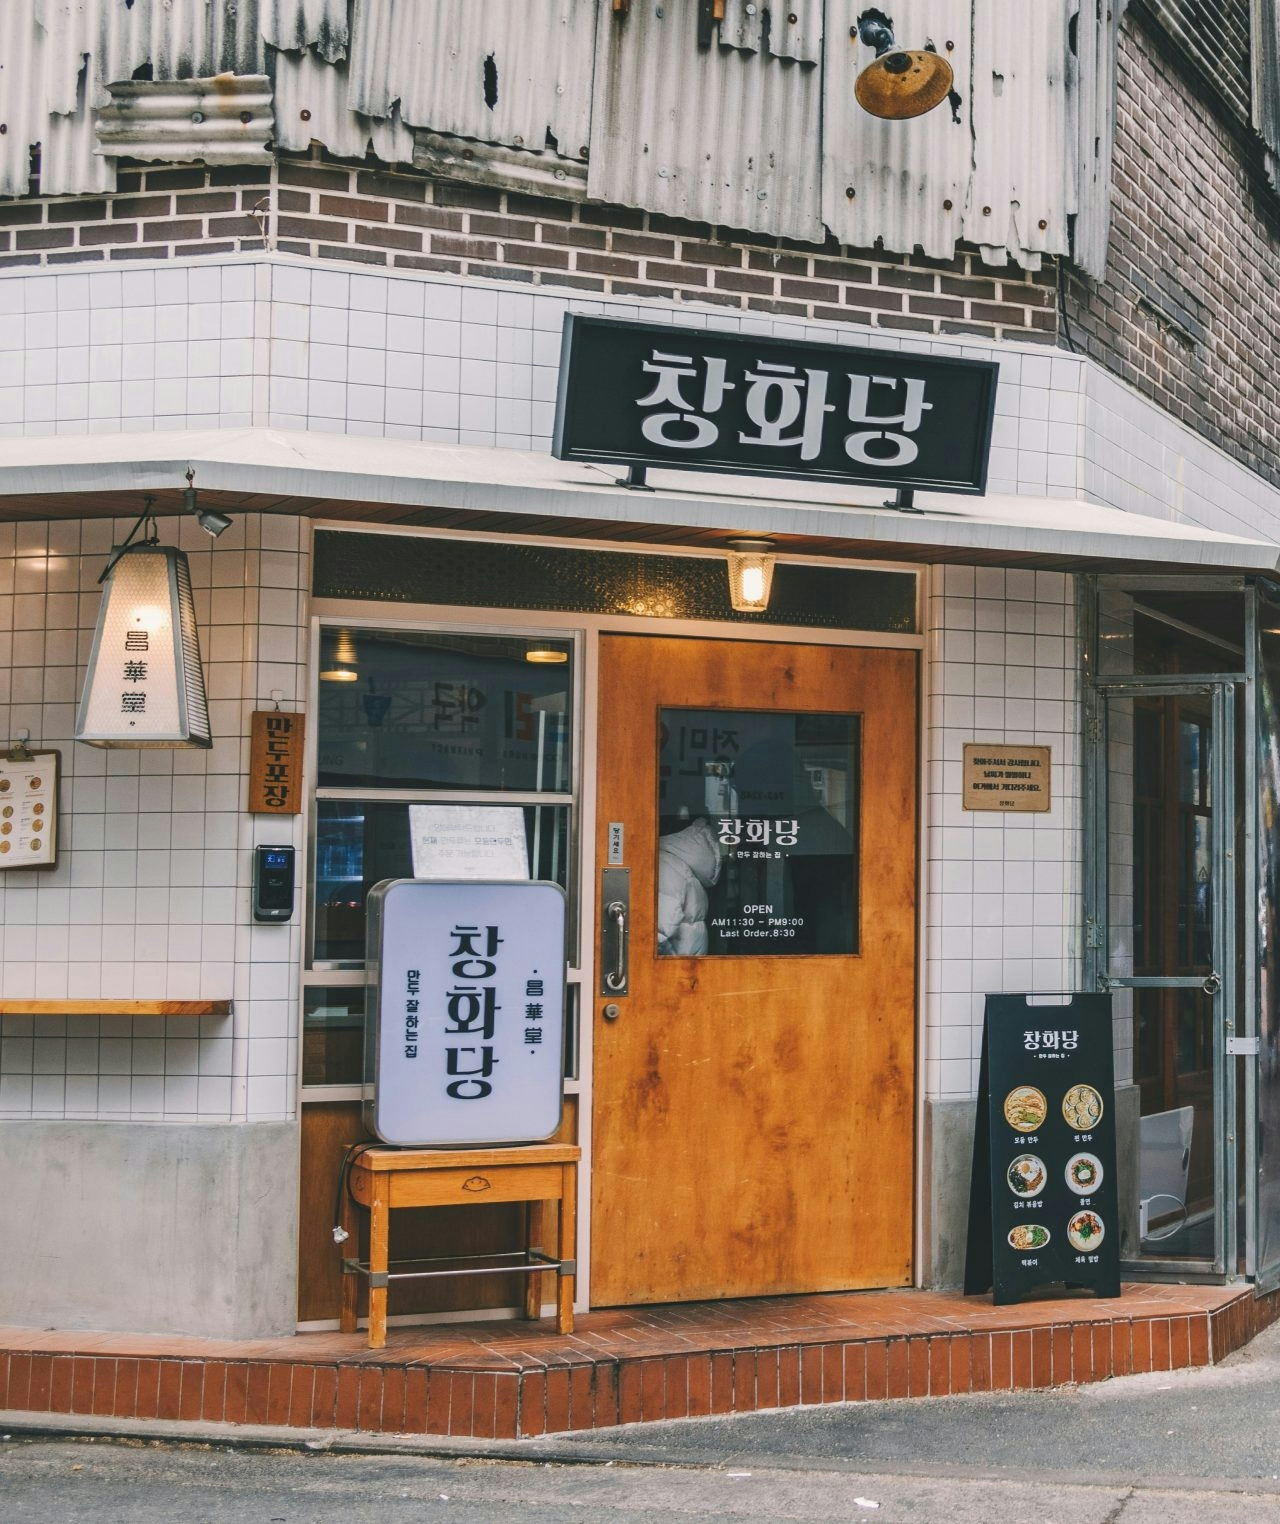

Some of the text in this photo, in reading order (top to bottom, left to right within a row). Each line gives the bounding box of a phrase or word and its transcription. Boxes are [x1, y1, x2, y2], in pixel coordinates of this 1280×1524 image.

[635, 349, 933, 466] 창화당
[264, 717, 293, 808] 만두포장
[717, 818, 800, 846] 창화당
[737, 851, 781, 859] 만두 잘하는 집
[743, 904, 773, 914] OPEN
[711, 918, 755, 926] AM11:30
[768, 918, 804, 926] PM9:00
[720, 929, 740, 937] Last
[404, 969, 421, 1059] 만두 잘하는 집
[444, 924, 505, 1100] 창화당
[524, 979, 544, 1044] 昌華堂
[1023, 1030, 1080, 1050] 창화당
[1027, 1135, 1039, 1144] 만두
[1081, 1134, 1093, 1142] 만두
[1013, 1200, 1043, 1209] 김치 볶음밥
[1021, 1258, 1038, 1267] 떡볶이
